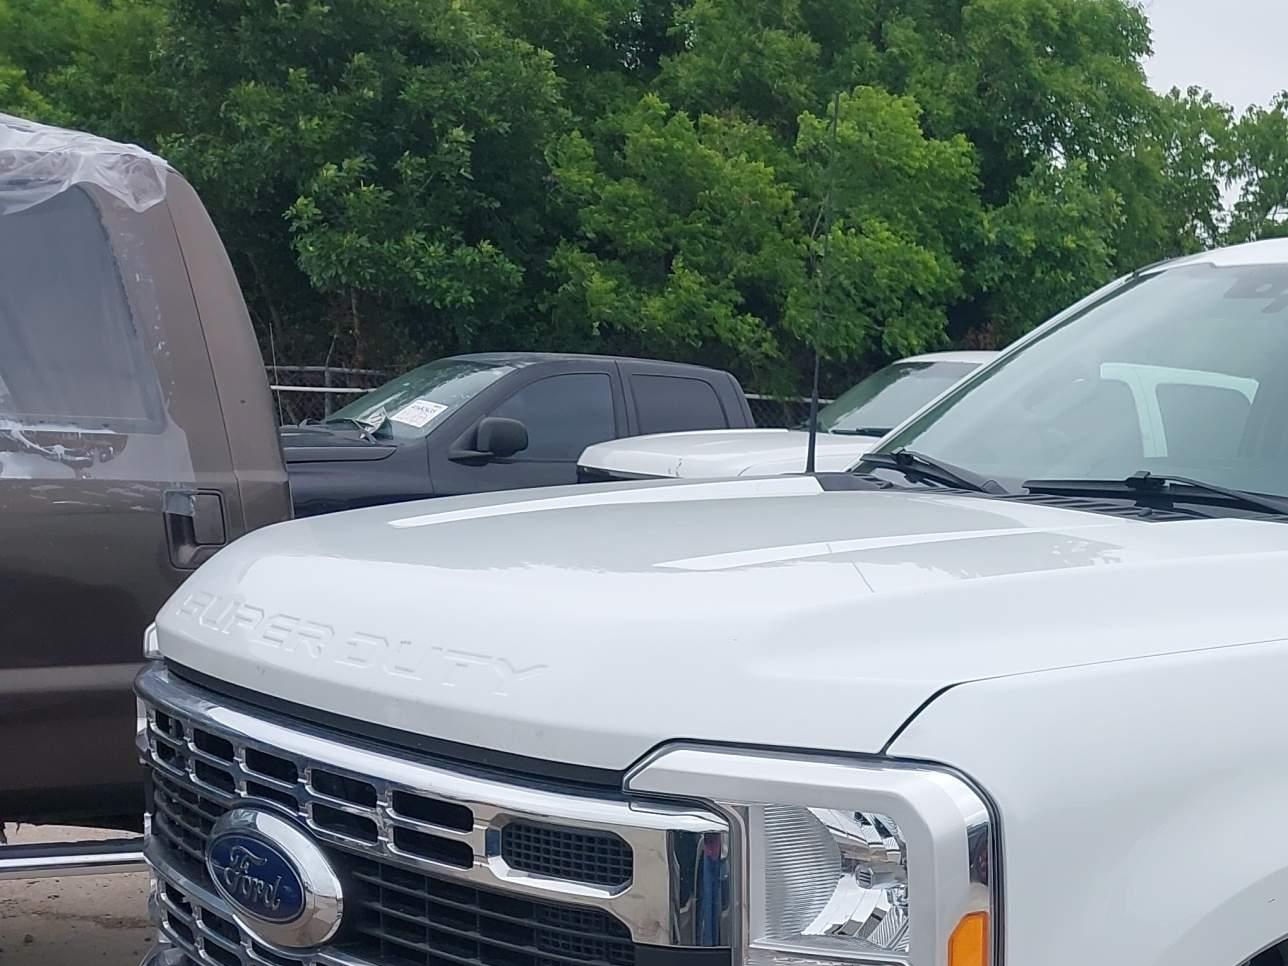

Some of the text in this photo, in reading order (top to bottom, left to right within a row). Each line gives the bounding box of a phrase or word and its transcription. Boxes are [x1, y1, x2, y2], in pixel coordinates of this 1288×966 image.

[175, 590, 550, 697] SUPER DUTY
[223, 845, 282, 912] Ford
